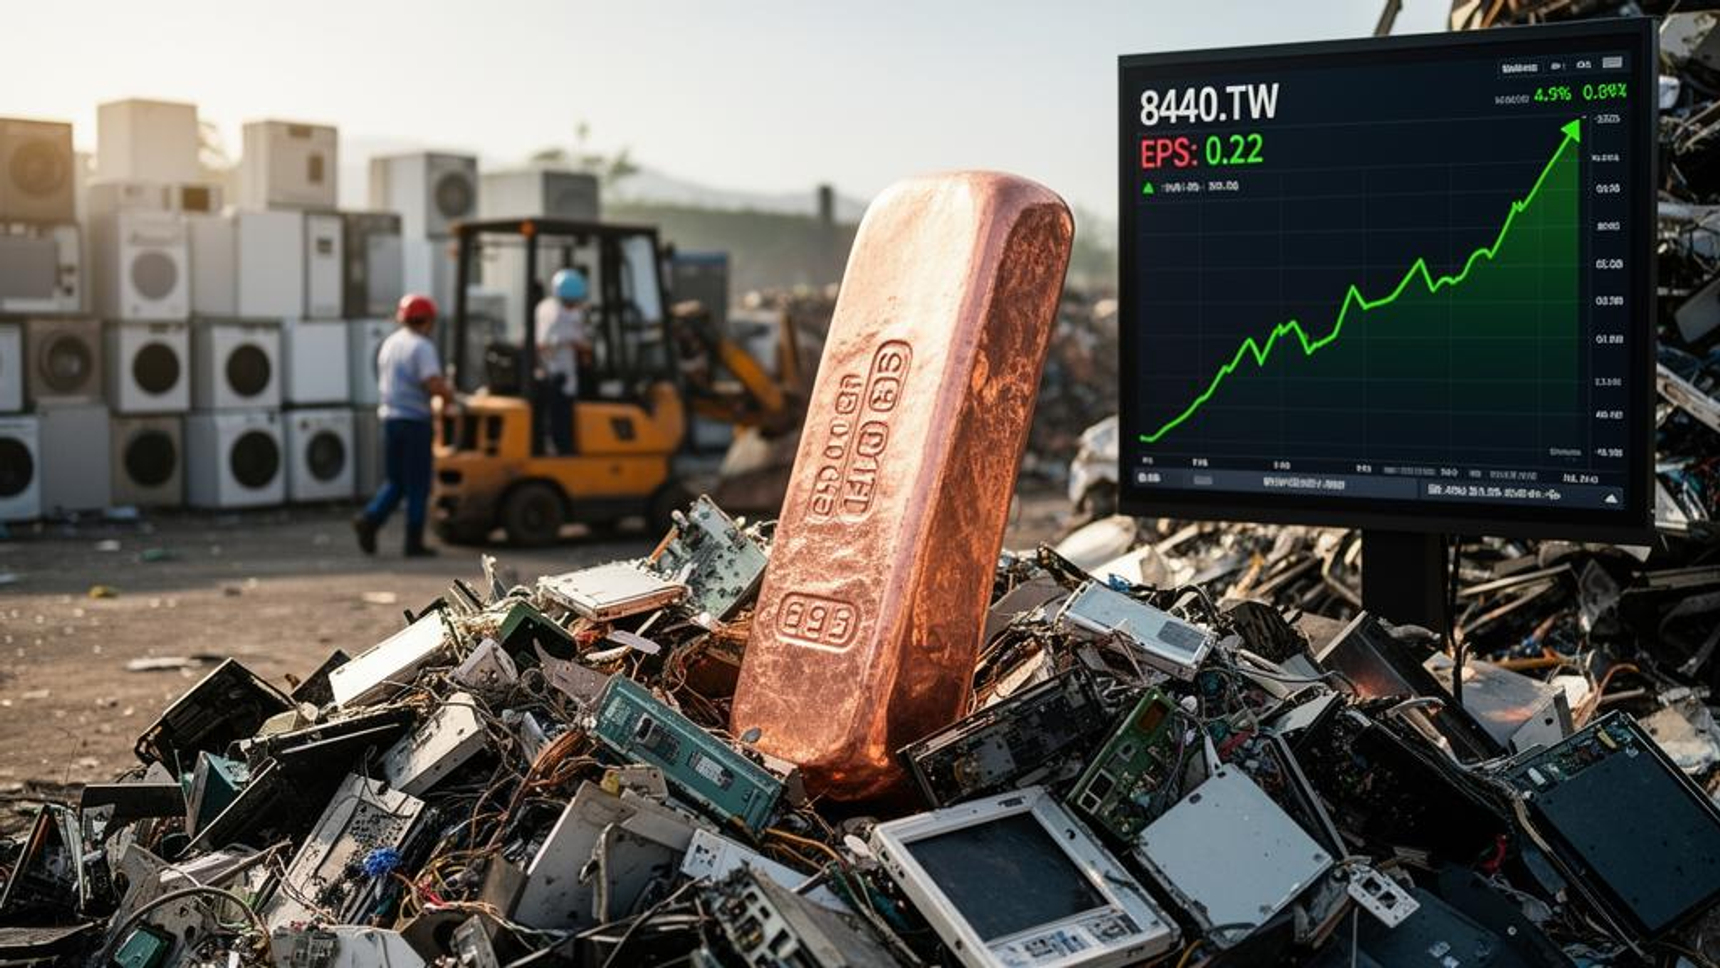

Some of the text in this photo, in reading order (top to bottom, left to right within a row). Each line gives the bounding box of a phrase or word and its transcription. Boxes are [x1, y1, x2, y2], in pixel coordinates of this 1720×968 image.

[1140, 83, 1279, 126] 8440.TW
[1140, 133, 1264, 169] EPS: 0.22
